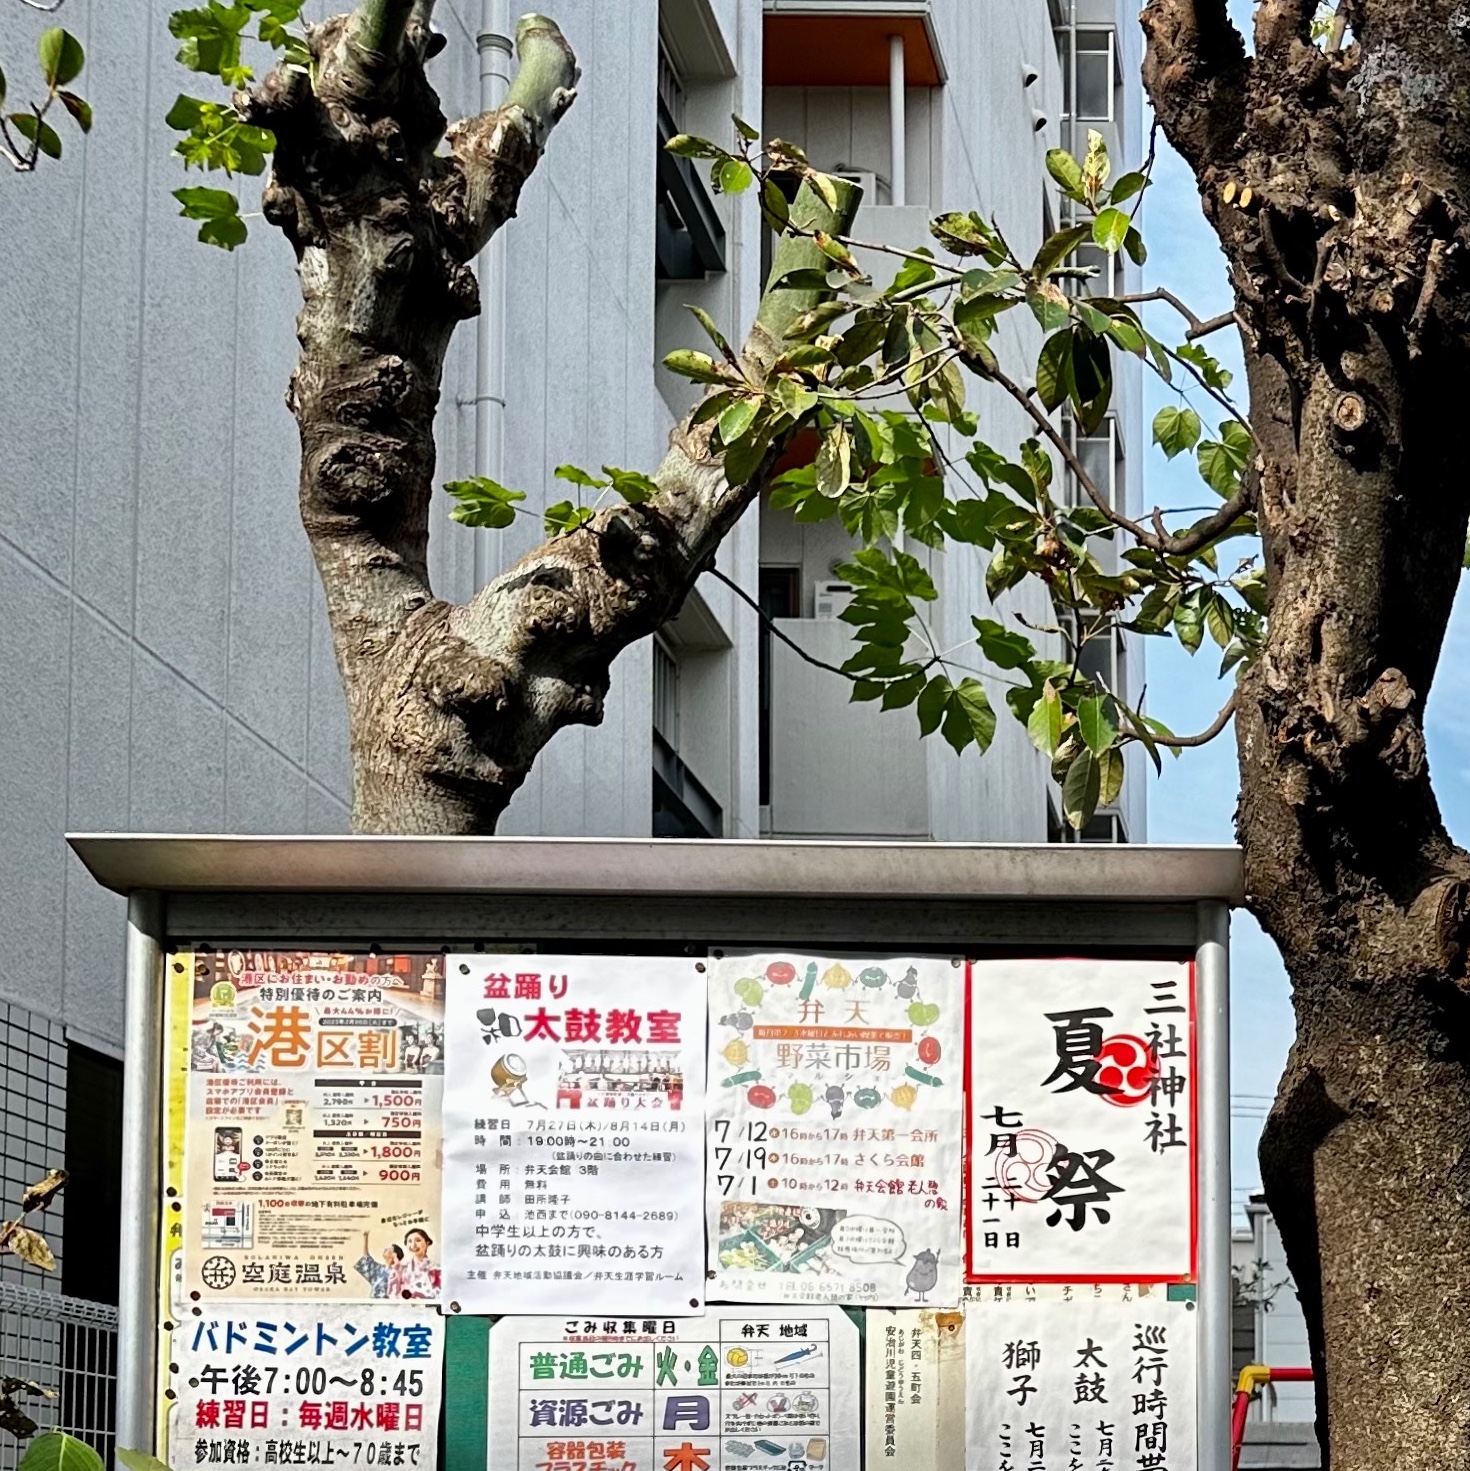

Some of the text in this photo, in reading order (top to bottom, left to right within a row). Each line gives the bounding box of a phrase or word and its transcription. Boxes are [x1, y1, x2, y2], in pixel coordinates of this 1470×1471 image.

[260, 988, 382, 1002] 特別優待のご案内
[484, 973, 568, 1000] 盆踊り
[797, 1000, 871, 1025] 弁天
[247, 1005, 397, 1068] 港区割
[523, 1007, 682, 1044] 太鼓教室
[776, 1043, 891, 1072] 野菜市場
[1143, 980, 1188, 1155] 三社神社
[372, 1095, 422, 1108] 1,500円
[381, 1116, 421, 1128] 750円
[474, 1118, 511, 1130] 練習日
[1040, 1006, 1126, 1232] 夏祭
[980, 1105, 1023, 1157] 七月
[370, 1146, 421, 1159] 1,800円
[854, 1153, 925, 1168] さくら会館
[379, 1169, 420, 1182] 900円
[525, 1163, 571, 1176] 弁天会館
[525, 1179, 547, 1190] 無料
[475, 1223, 603, 1239] 中学生以上の方で、
[475, 1243, 664, 1260] 盆踊りの太鼓に興味のある方
[242, 1262, 347, 1284] 空庭温泉
[564, 1320, 676, 1335] ごみ収集曜日
[741, 1323, 808, 1338] 弁天 地域
[191, 1320, 432, 1359] バドミントン教室
[529, 1351, 644, 1380] 普通ごみ
[1002, 1340, 1041, 1407] 獅子
[1073, 1338, 1108, 1405] 太鼓
[529, 1399, 644, 1428] 資源ごみ
[662, 1395, 711, 1431] 月
[546, 1440, 627, 1461] 容器包装
